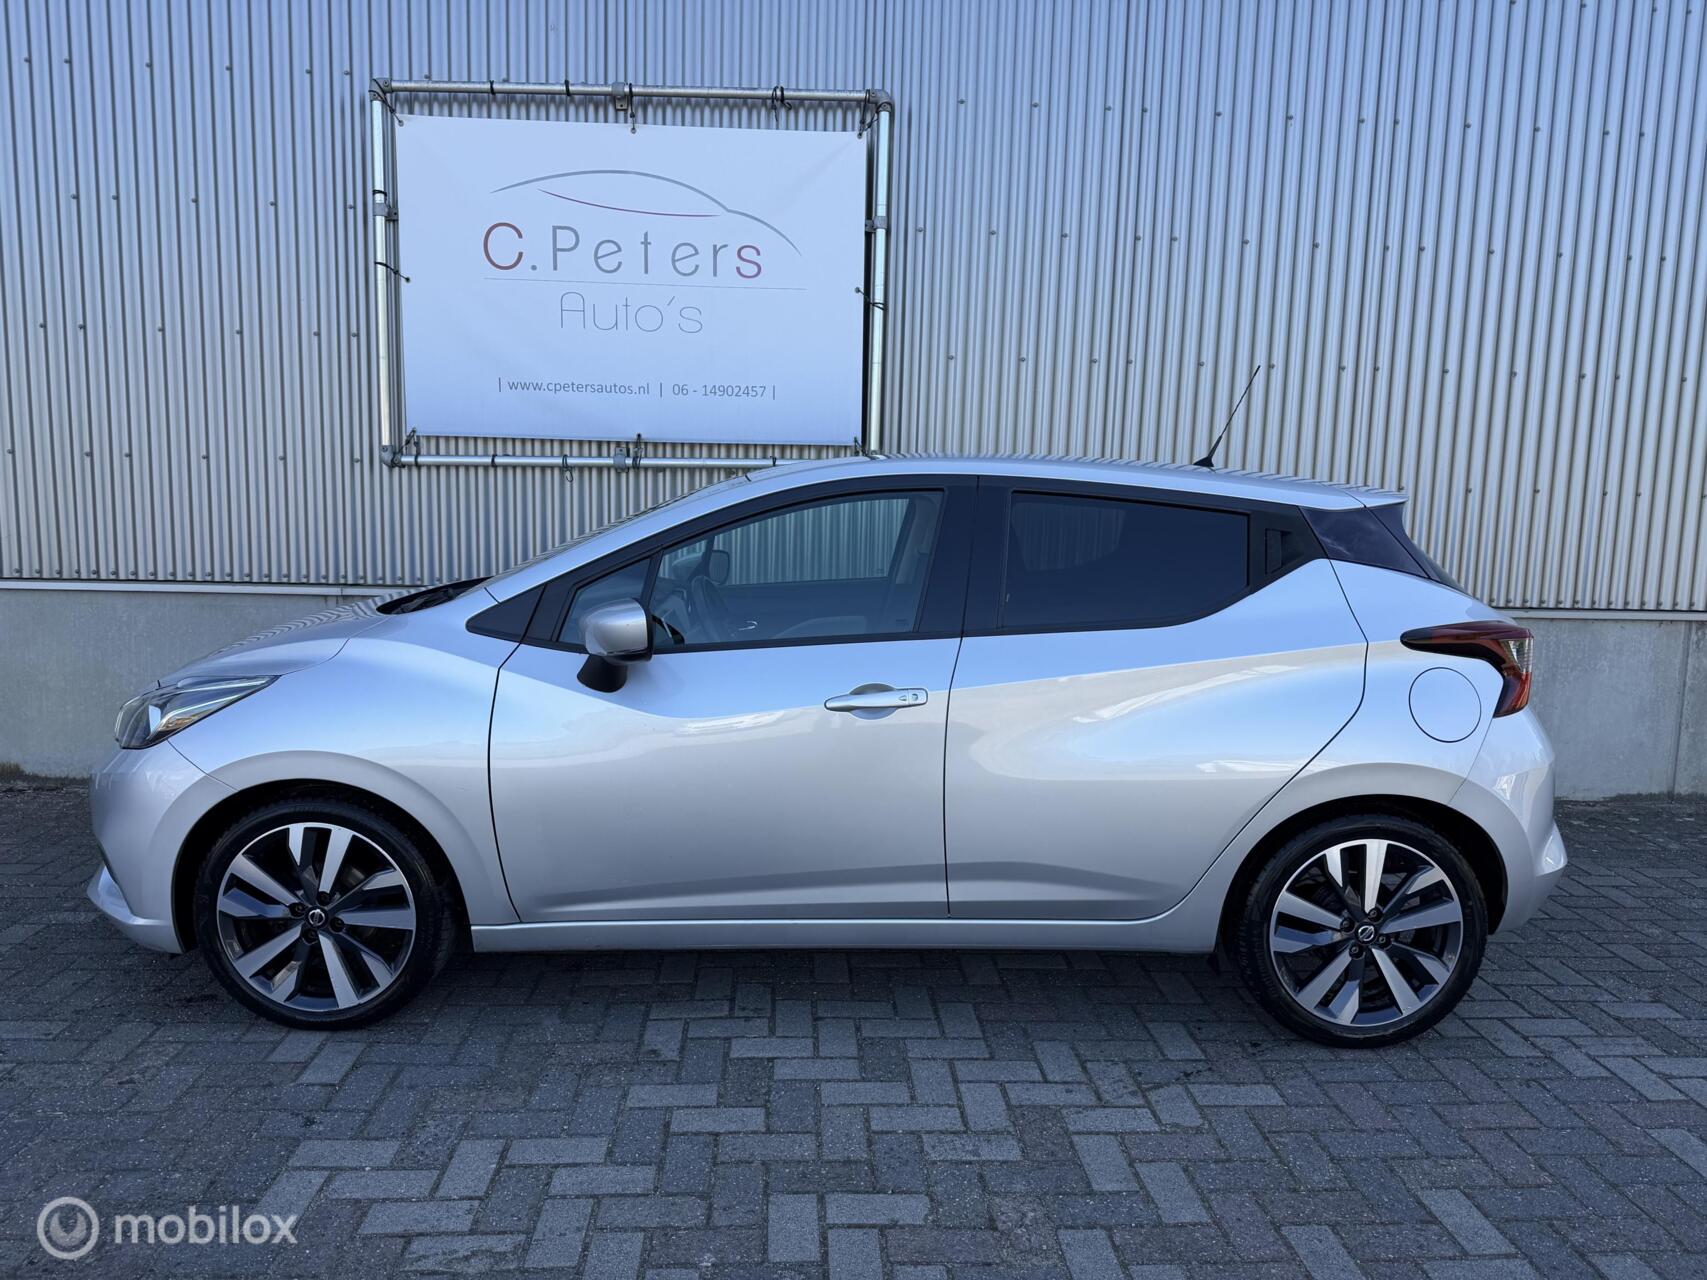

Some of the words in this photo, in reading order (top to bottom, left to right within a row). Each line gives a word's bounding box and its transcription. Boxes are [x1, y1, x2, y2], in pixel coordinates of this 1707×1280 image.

[507, 379, 650, 396] www.cpetersautos.nl
[672, 383, 689, 396] 06
[702, 384, 767, 399] 14902457
